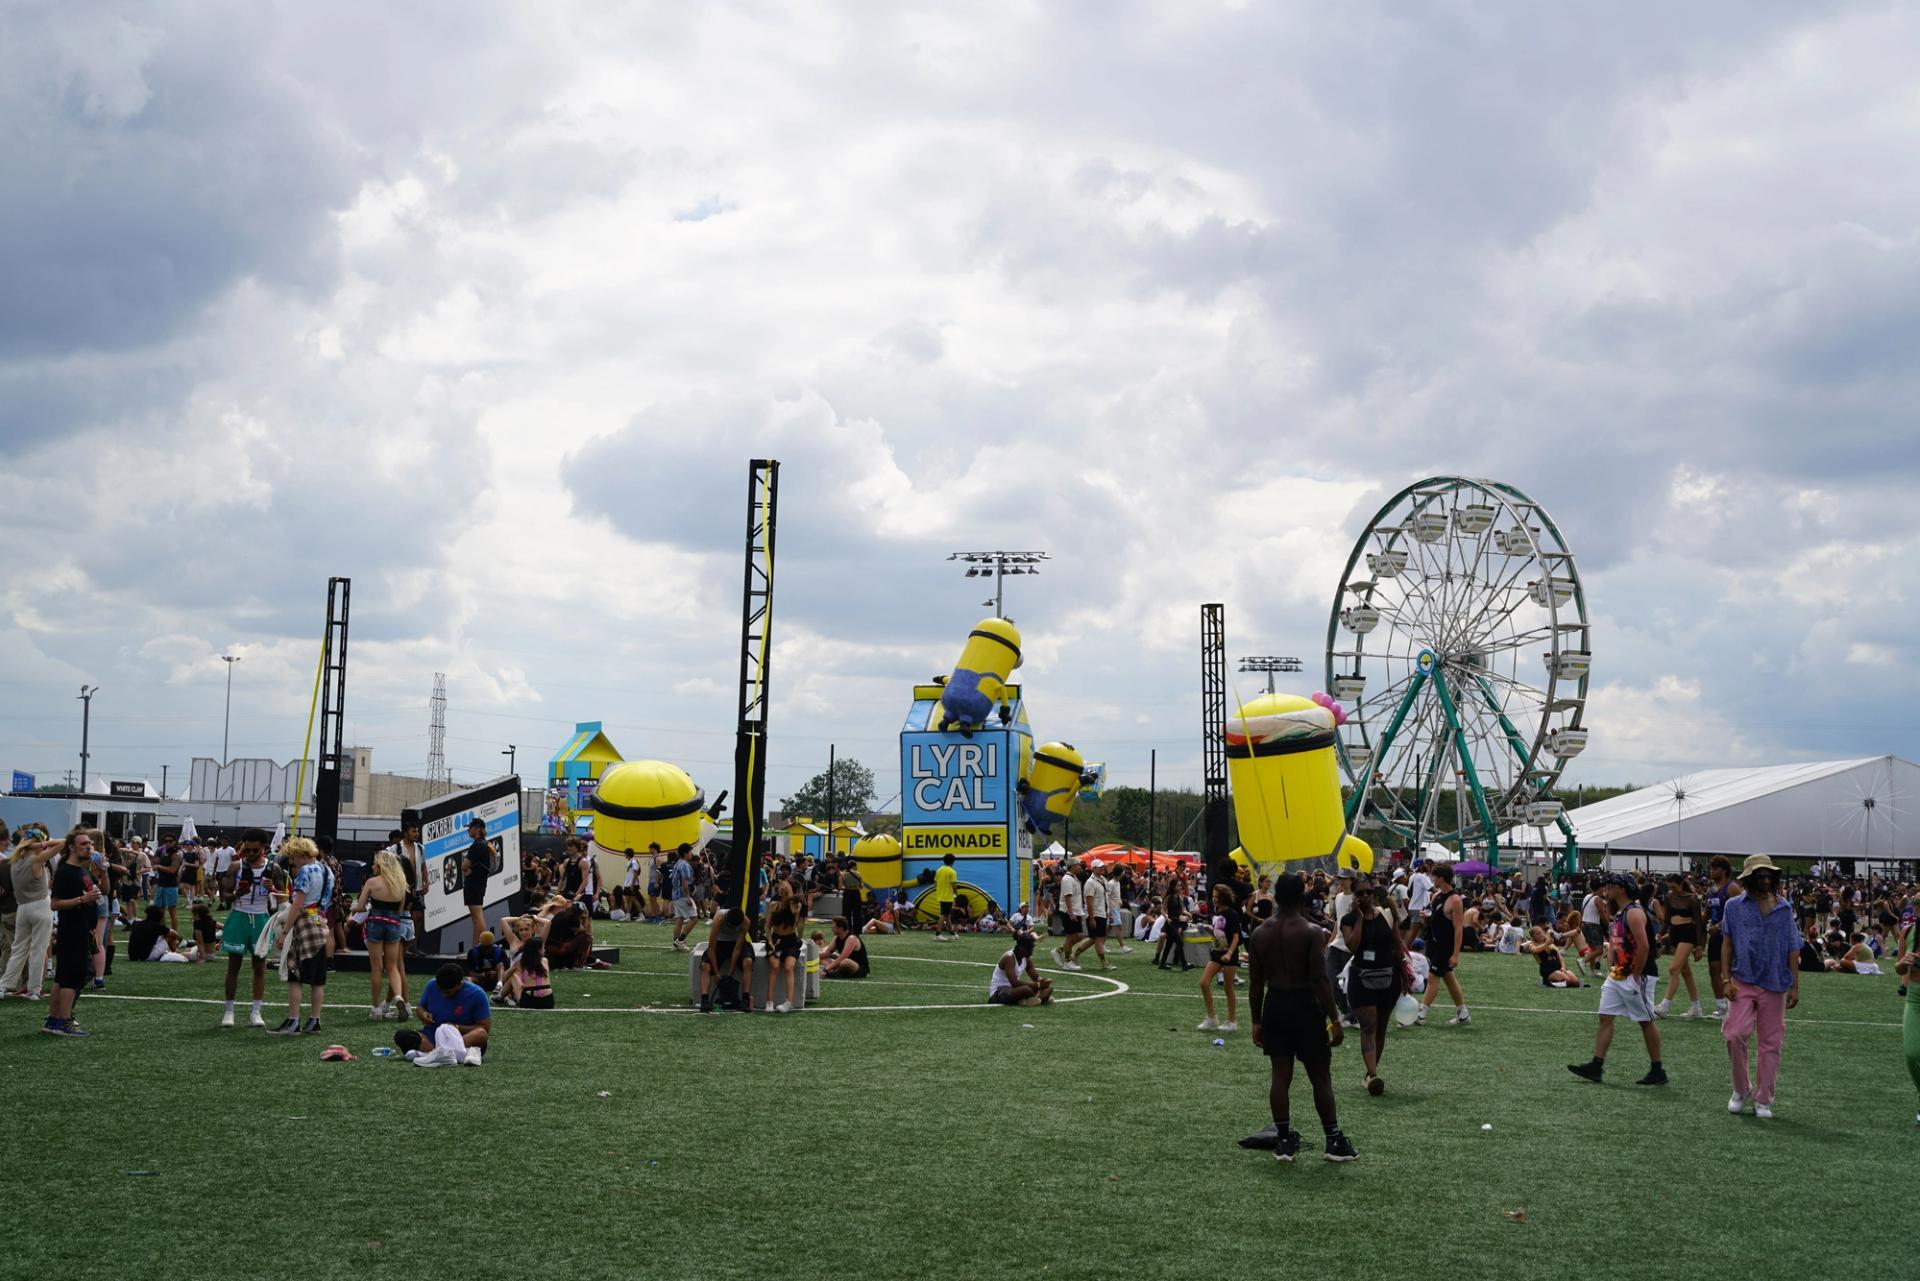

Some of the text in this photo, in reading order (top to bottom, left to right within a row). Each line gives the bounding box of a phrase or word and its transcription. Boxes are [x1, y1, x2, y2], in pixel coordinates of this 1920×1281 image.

[911, 743, 997, 778] LYRI
[914, 777, 996, 811] CAL
[906, 834, 1002, 849] LEMONADE
